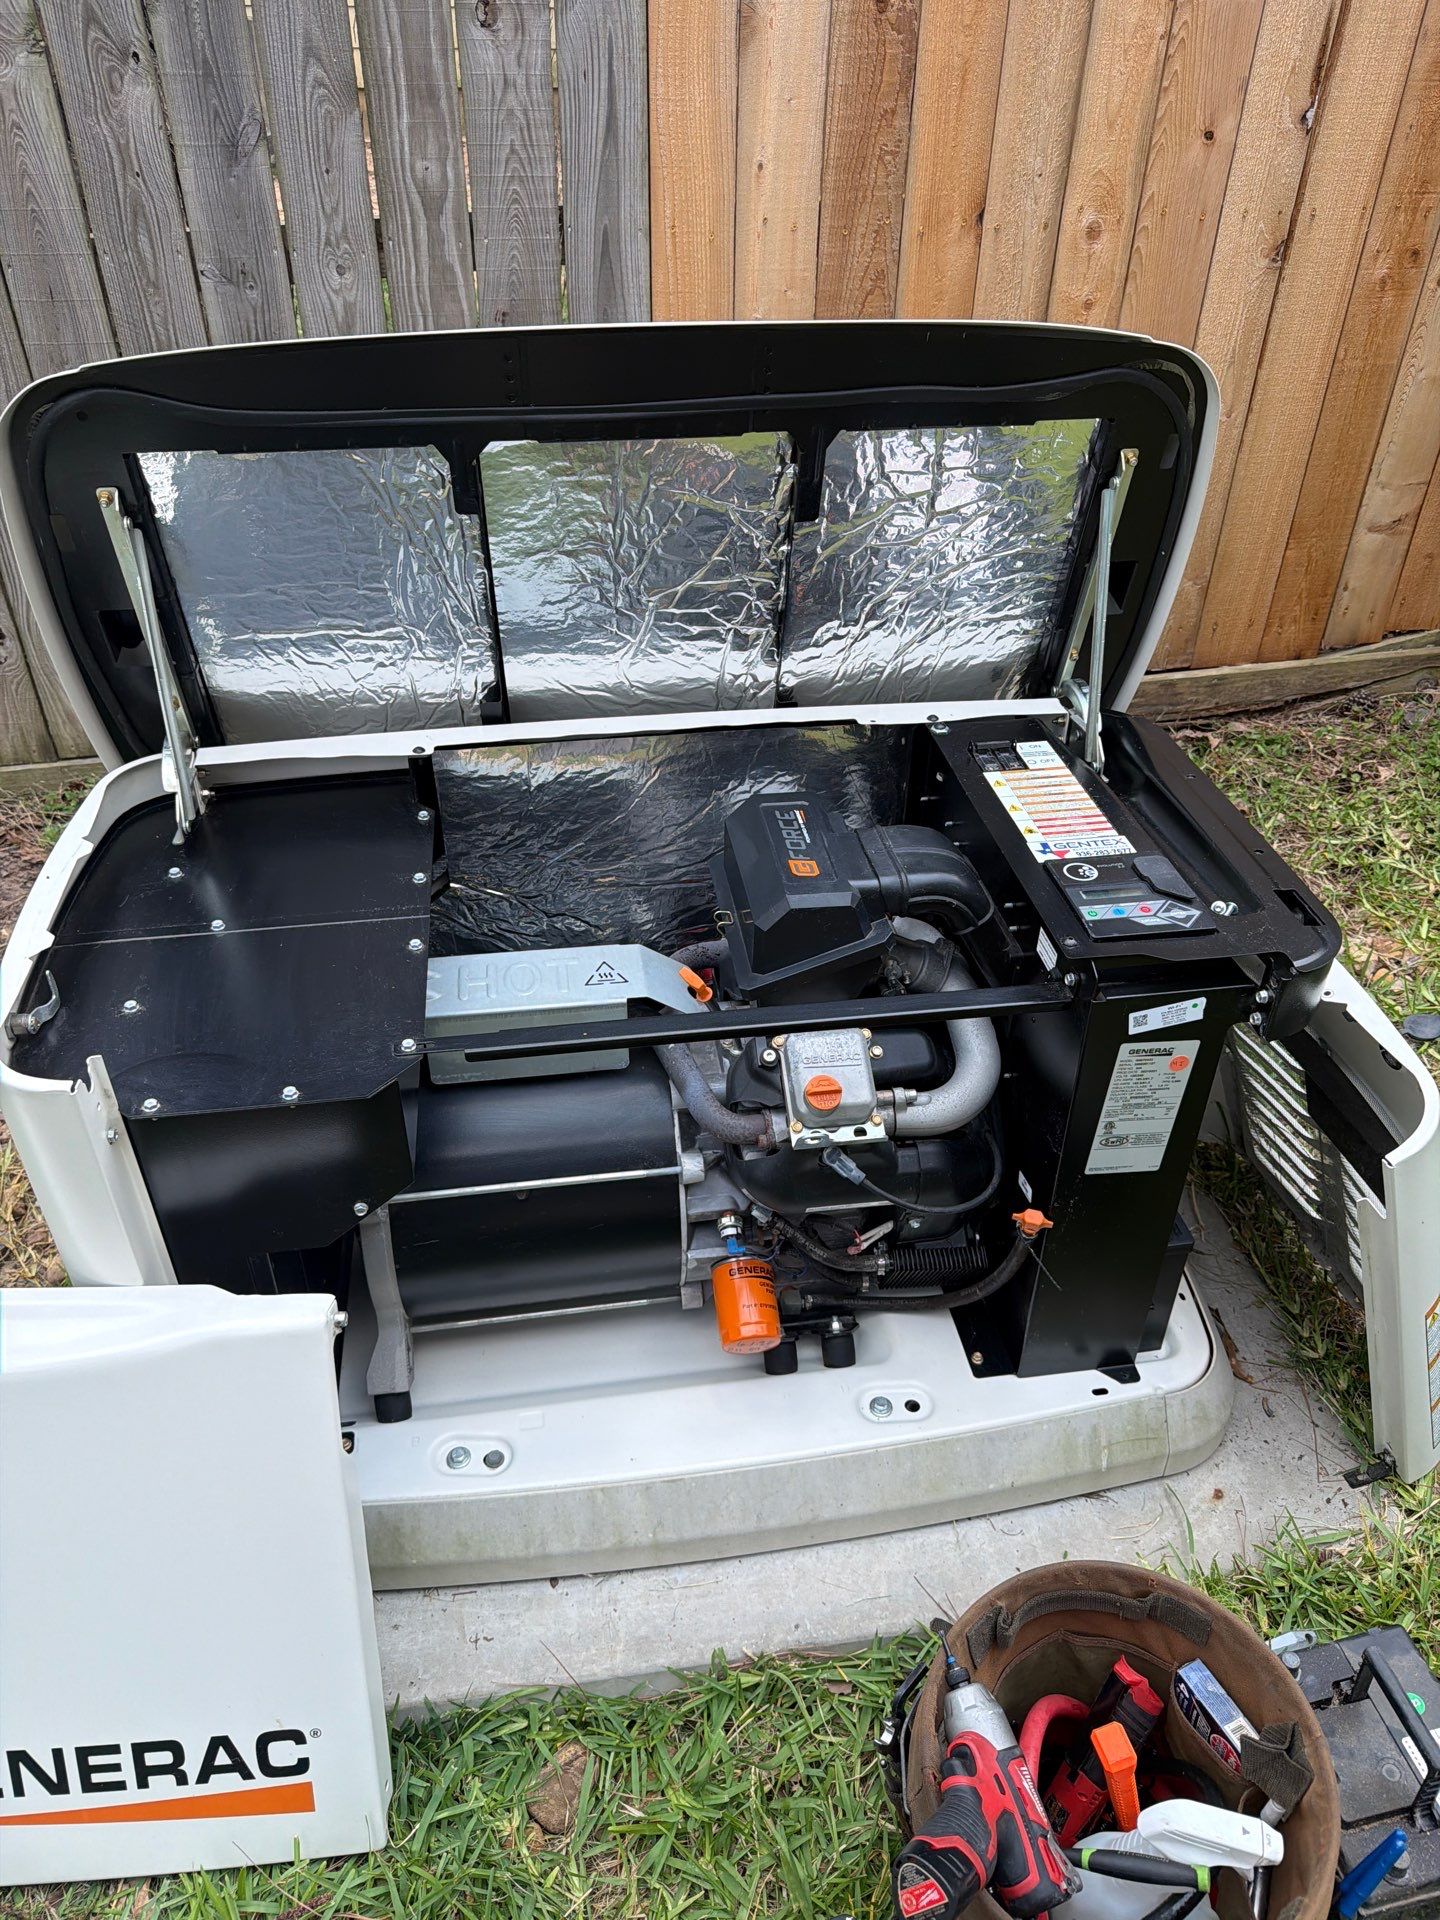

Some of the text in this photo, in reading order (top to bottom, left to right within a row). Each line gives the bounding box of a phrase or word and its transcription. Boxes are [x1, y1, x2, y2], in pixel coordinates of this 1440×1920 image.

[1053, 838, 1127, 850] GENTEX
[456, 957, 579, 1001] HOT
[1128, 1047, 1175, 1055] GENERAC
[0, 1728, 311, 1799] NERAC
